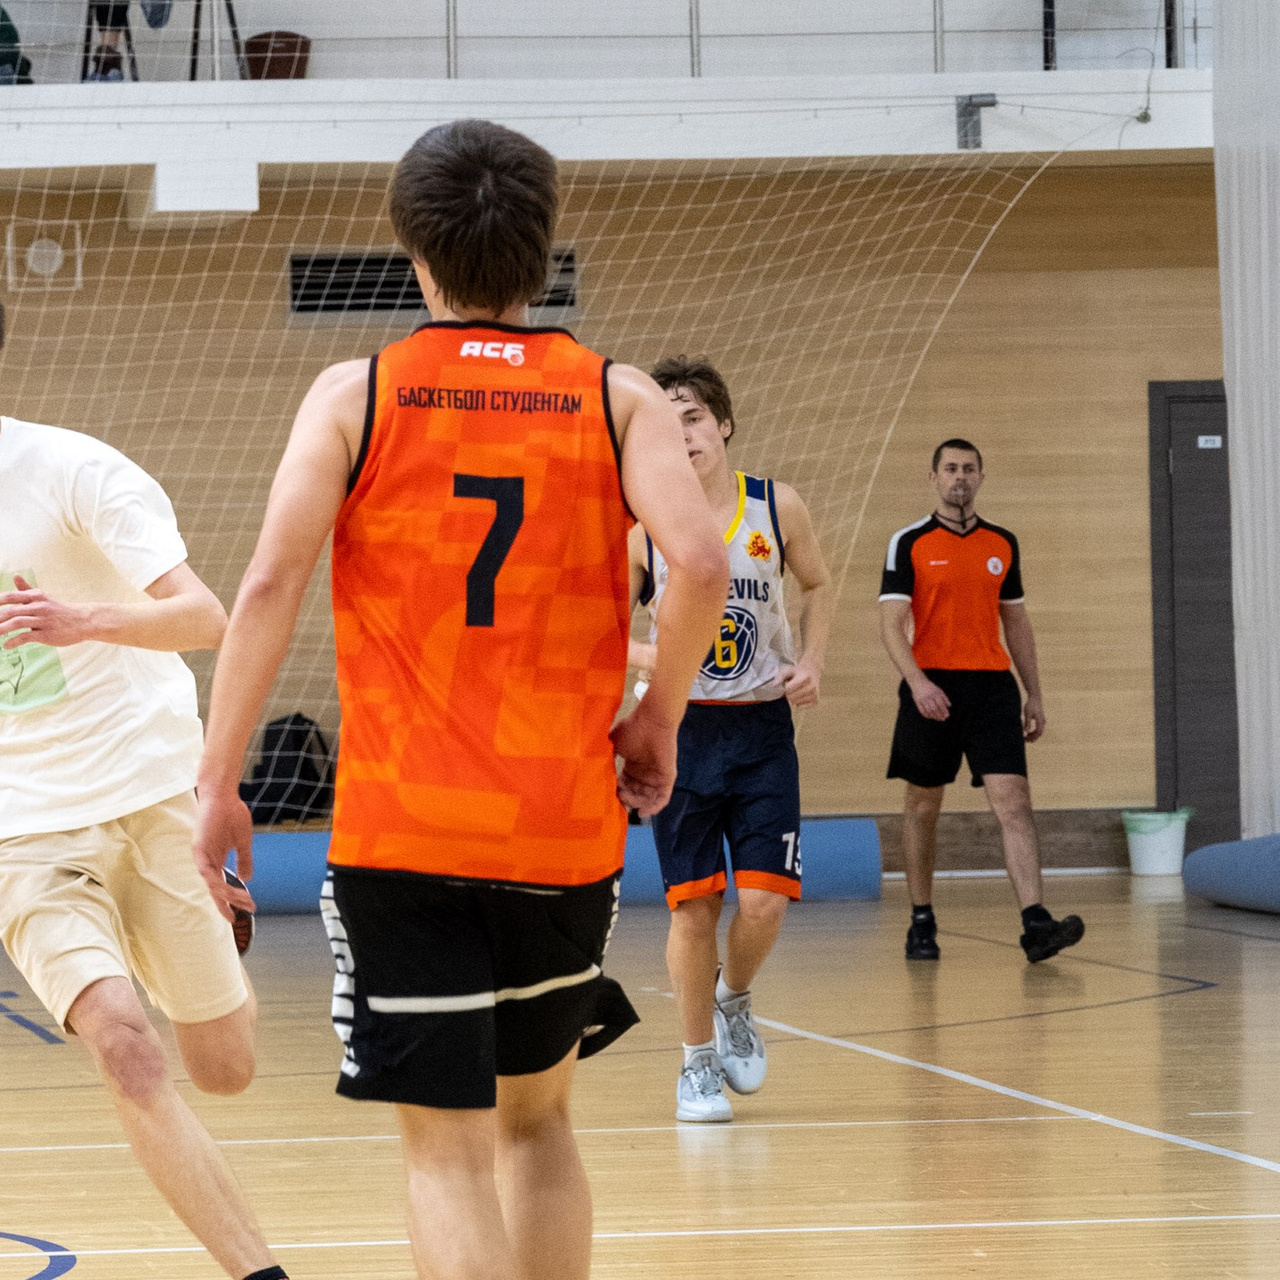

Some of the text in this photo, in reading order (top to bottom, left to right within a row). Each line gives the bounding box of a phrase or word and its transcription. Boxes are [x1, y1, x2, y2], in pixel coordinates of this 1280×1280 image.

[397, 387, 582, 414] БАСКЕТБОЛ СТУДЕНТАМ
[453, 473, 524, 627] 7
